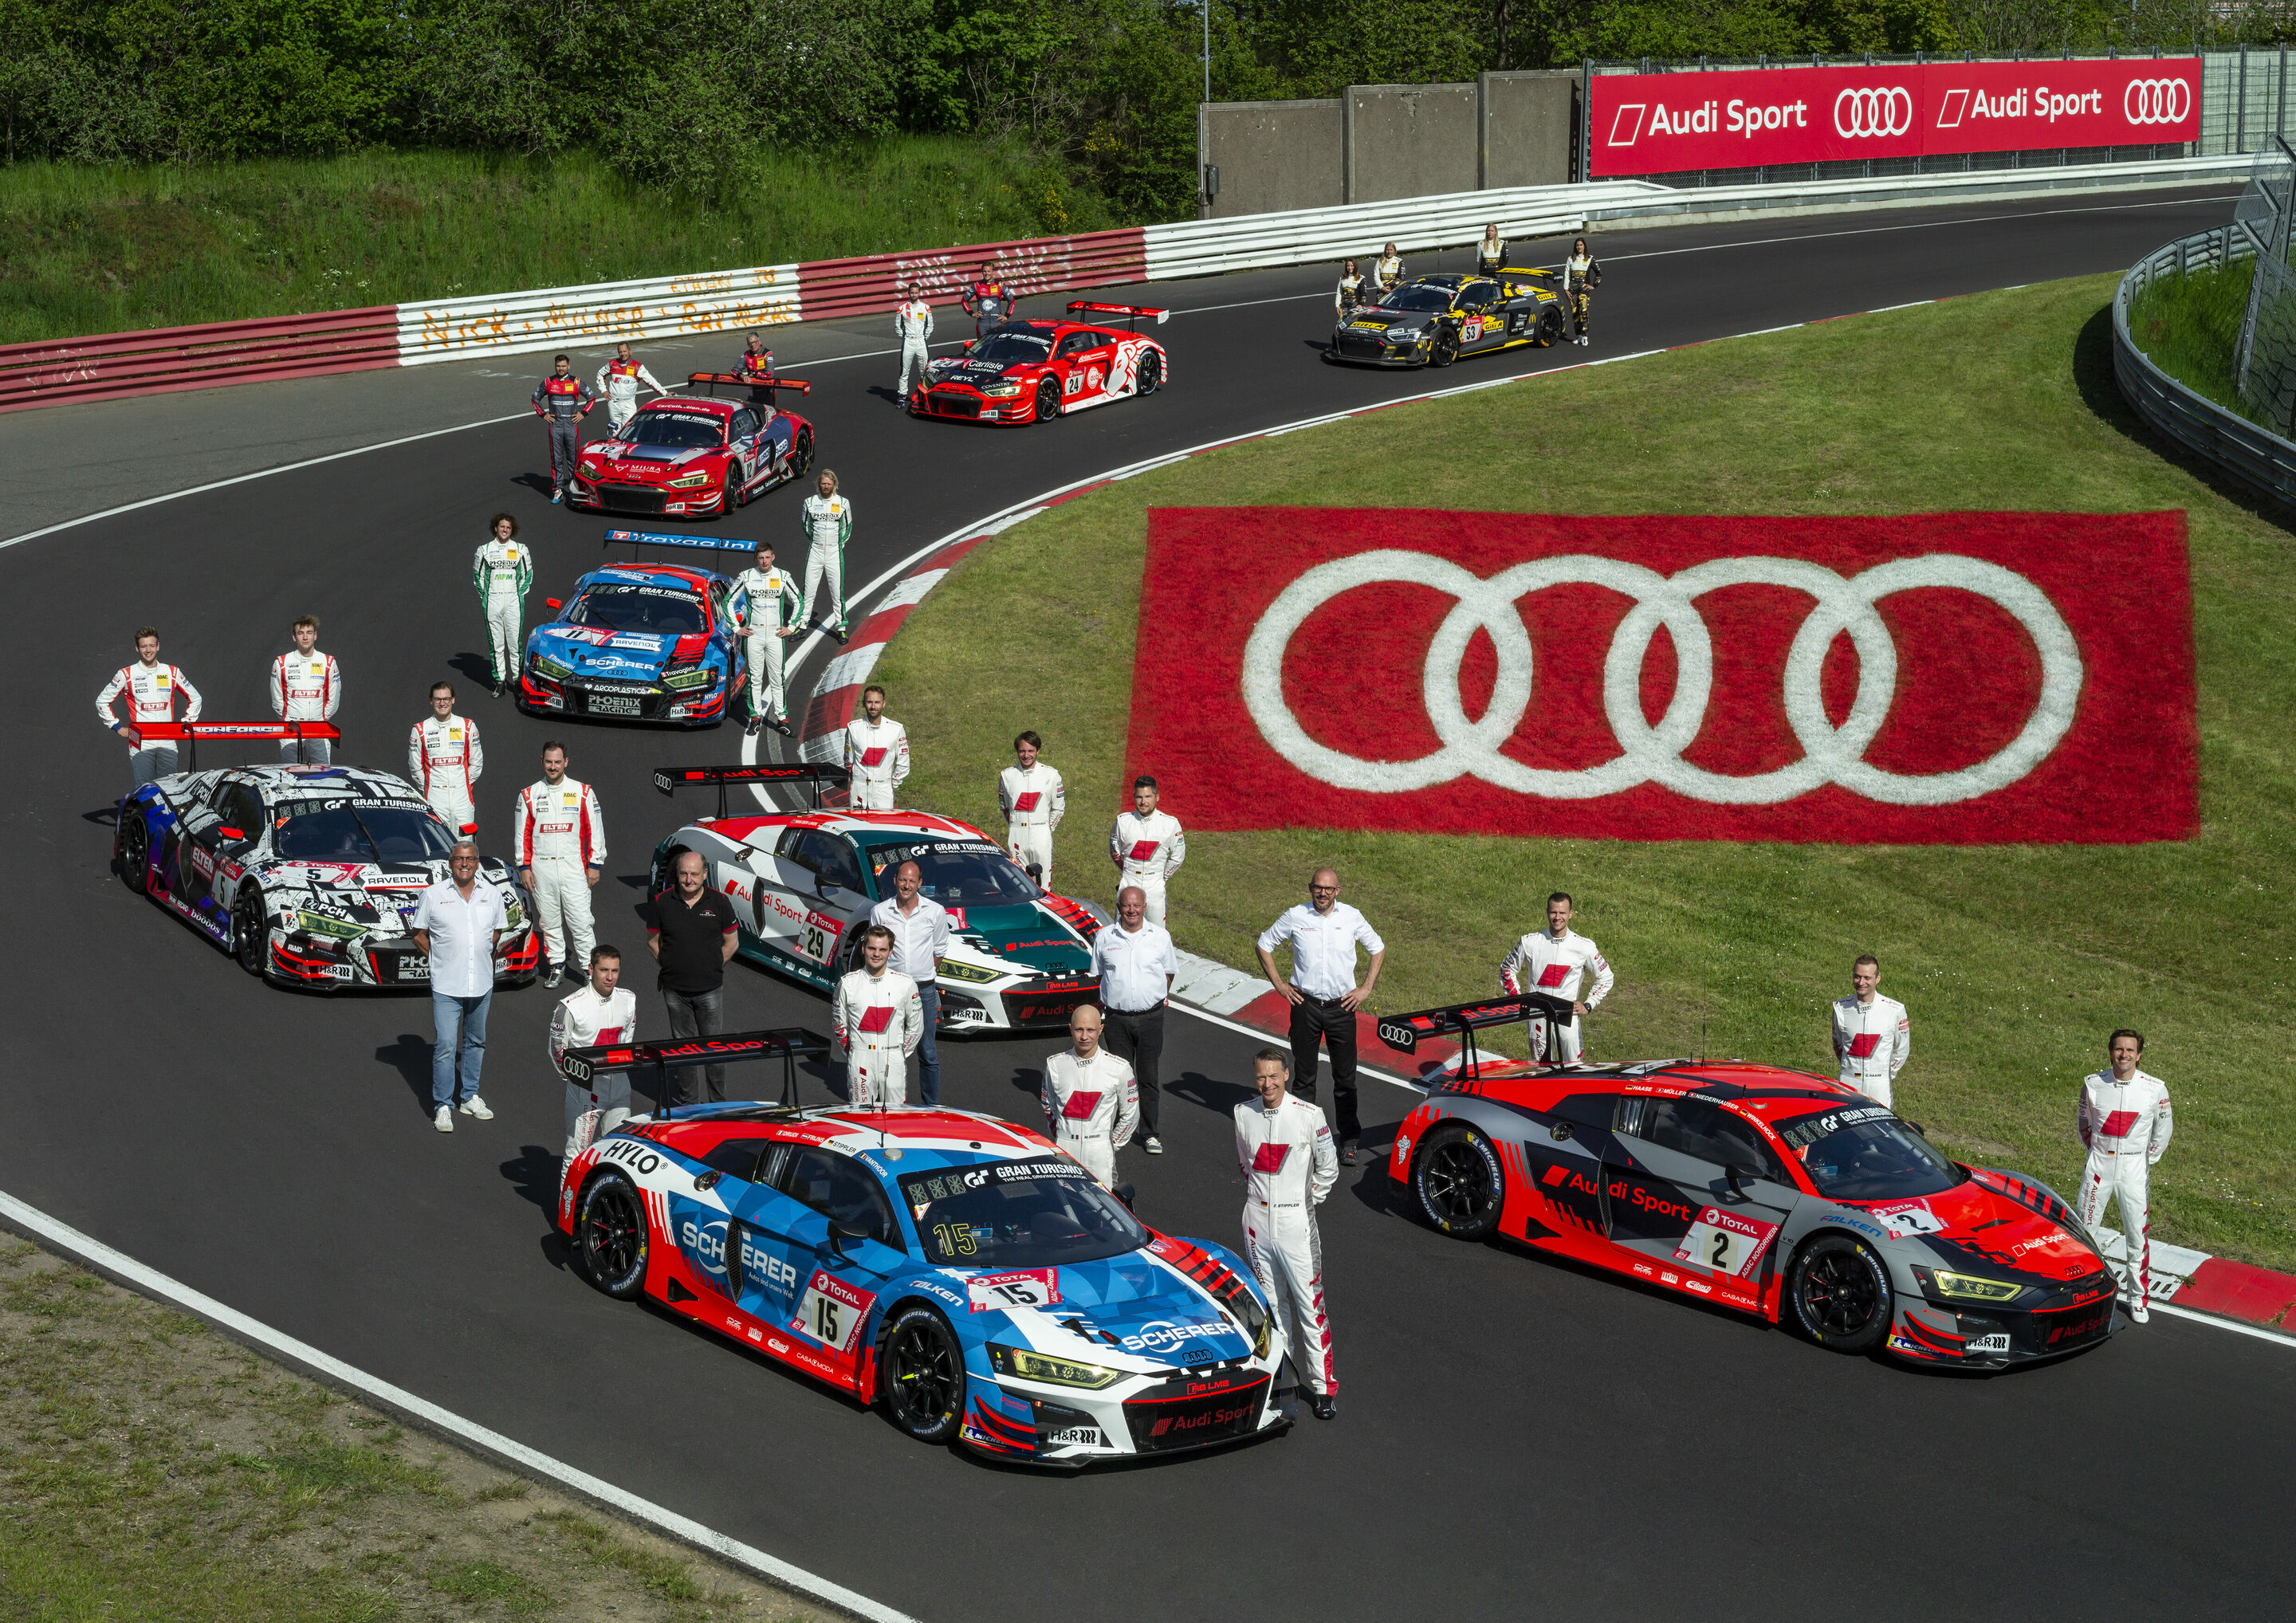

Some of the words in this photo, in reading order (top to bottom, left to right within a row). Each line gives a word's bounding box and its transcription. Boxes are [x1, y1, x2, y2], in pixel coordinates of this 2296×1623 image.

[1971, 87, 2028, 116] Audi
[2034, 87, 2102, 123] Sport
[1649, 100, 1719, 137] Audi
[1727, 98, 1807, 139] Sport
[1466, 325, 1475, 340] 53
[969, 360, 1005, 371] Carlisle
[1069, 377, 1079, 393] 24
[691, 415, 719, 426] TURISMO
[746, 462, 753, 478] 12
[639, 587, 662, 595] GRAN
[663, 589, 699, 602] TURISMO
[565, 630, 584, 639] 11
[615, 639, 656, 648] RAVENOL
[585, 658, 655, 671] SCHERER
[666, 665, 696, 678] Travaglini
[384, 800, 427, 811] TURISMO
[963, 843, 999, 853] TURISMO
[192, 847, 215, 874] ELTEN
[224, 862, 238, 878] TOTAL
[306, 869, 321, 880] 5
[368, 876, 424, 885] RAVENOL
[220, 877, 226, 903] 5
[319, 902, 348, 917] PCH
[737, 885, 773, 907] Audi
[774, 898, 803, 925] Sport
[817, 918, 836, 931] TOTAL
[287, 944, 303, 953] RWD
[807, 927, 824, 958] 29
[1019, 940, 1044, 949] Audi
[1045, 939, 1075, 948] Sport
[320, 965, 338, 975] H&R
[952, 1008, 971, 1019] H&R
[1037, 1005, 1066, 1016] Audi
[1695, 1093, 1740, 1110] NIEDERHAUSER
[1747, 1112, 1777, 1141] WINKELHOCK
[1839, 1109, 1865, 1122] GRAN
[603, 1141, 660, 1174] HYLO
[807, 1134, 825, 1143] FRIJNS
[832, 1142, 857, 1153] STIPPLER
[864, 1156, 889, 1178] VANTHOOR
[997, 1165, 1031, 1178] GRAN
[1033, 1163, 1082, 1176] TURISMO
[1479, 1143, 1500, 1190] MICHELIN
[586, 1175, 615, 1204] MICHELIN
[1417, 1174, 1438, 1221] MICHELIN
[1568, 1173, 1627, 1200] Audi
[1631, 1187, 1691, 1221] Sport
[1720, 1214, 1758, 1235] TOTAL
[1896, 1214, 1932, 1231] 2
[2086, 1204, 2096, 1226] Sport
[1820, 1215, 1882, 1238] FALKEN
[934, 1224, 977, 1256] 15
[1250, 1239, 1259, 1259] Audi
[2023, 1236, 2046, 1252] Audi
[2046, 1232, 2070, 1247] Sport
[682, 1221, 796, 1289] SCHERER
[1712, 1232, 1729, 1269] 2
[1741, 1259, 1755, 1279] ADAC
[1751, 1224, 1779, 1260] NORDRHEIN
[611, 1265, 642, 1291] MICHELIN
[748, 1271, 760, 1283] Autos
[1253, 1260, 1267, 1285] Sport
[1866, 1256, 1889, 1295] MICHELIN
[830, 1281, 859, 1305] TOTAL
[910, 1280, 964, 1307] FALKEN
[989, 1283, 1039, 1305] 15
[1050, 1290, 1059, 1303] ADAC
[1685, 1280, 1712, 1294] Eibach
[1721, 1291, 1740, 1302] CASA
[1747, 1300, 1769, 1311] MODA
[817, 1297, 839, 1343] 15
[846, 1335, 857, 1355] ADAC
[855, 1295, 877, 1336] NORDRHEIN
[900, 1311, 931, 1323] MICHELIN
[1121, 1322, 1236, 1349] SCHERER
[2063, 1322, 2086, 1338] Audi
[1968, 1338, 1991, 1348] H&R
[796, 1352, 812, 1364] CASA
[816, 1362, 834, 1373] MODA
[1208, 1380, 1229, 1391] LMS
[1173, 1411, 1212, 1432] Audi
[1214, 1402, 1255, 1425] Sport
[1051, 1429, 1078, 1441] H&R
